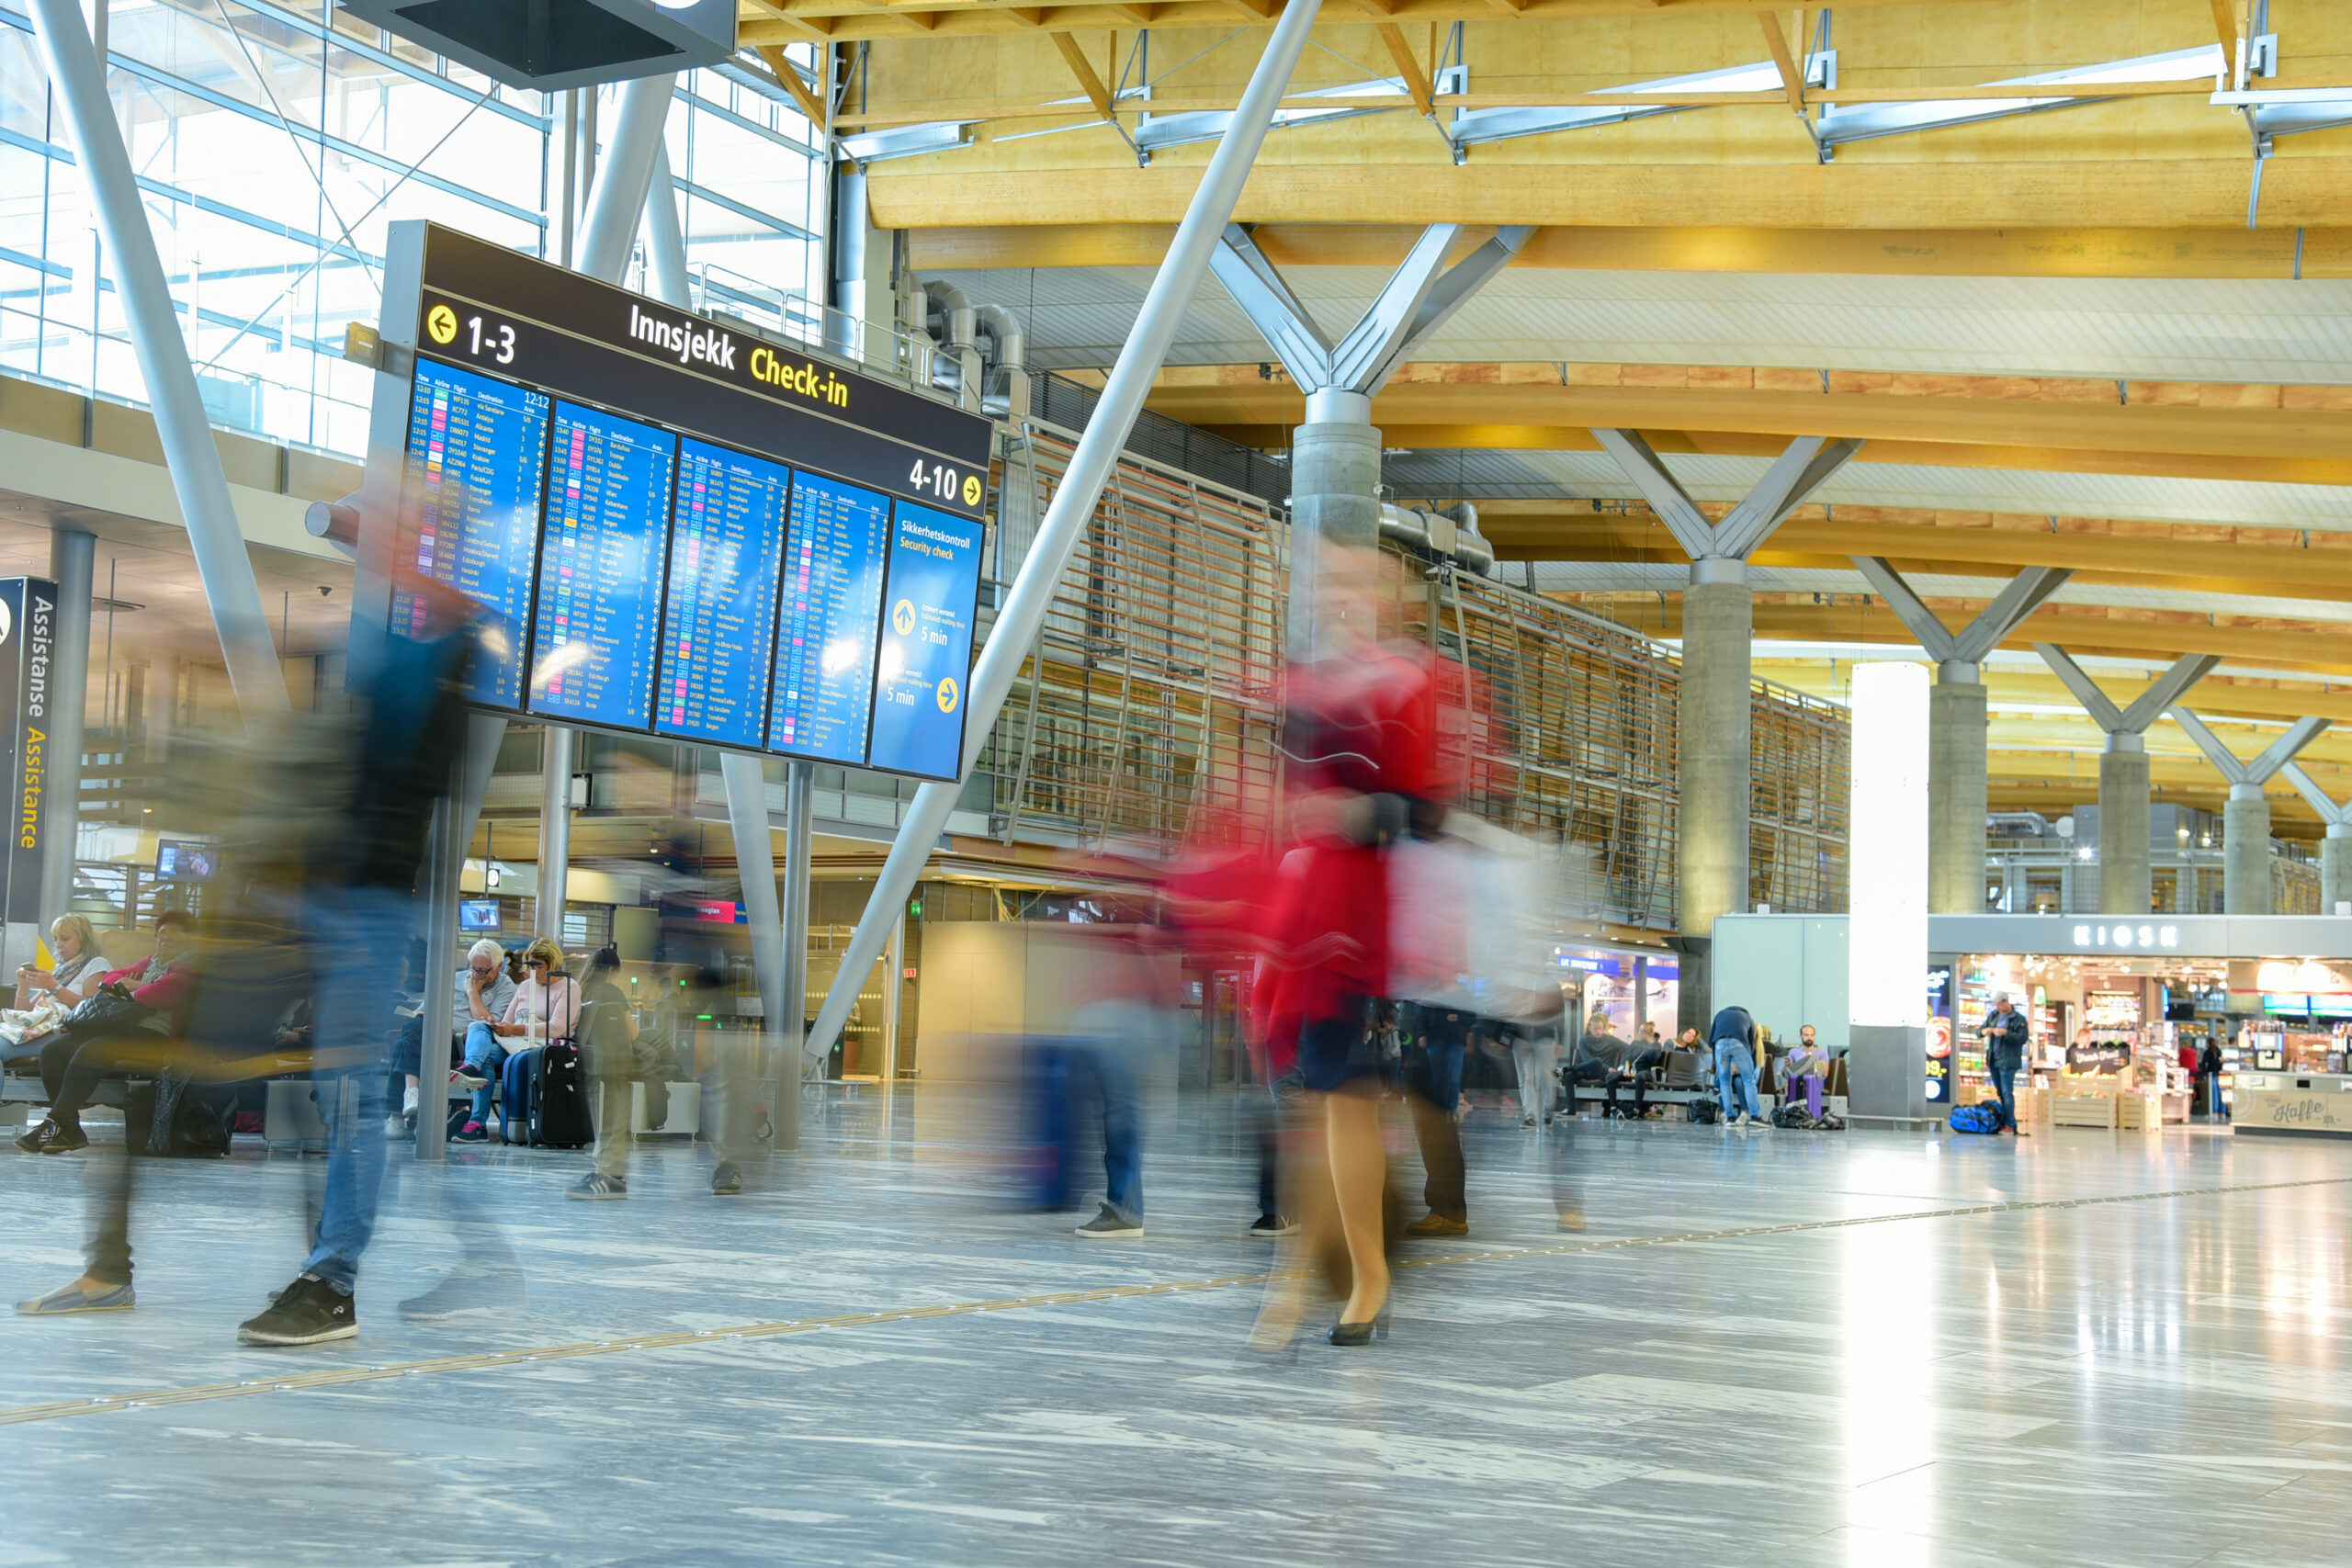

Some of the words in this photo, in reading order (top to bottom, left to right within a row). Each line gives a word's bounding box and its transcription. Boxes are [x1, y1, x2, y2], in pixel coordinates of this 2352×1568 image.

[468, 316, 516, 364] 1-3
[629, 304, 738, 371] Innsjekk
[750, 347, 849, 409] Check-in
[417, 385, 431, 395] 12:10
[418, 374, 429, 383] Time
[435, 379, 450, 389] Airline
[454, 385, 467, 394] Flight
[478, 392, 503, 405] Destination
[524, 406, 535, 414] Area
[525, 392, 549, 409] 12:12
[416, 396, 429, 405] 12:15
[476, 413, 493, 424] Antalya
[415, 406, 428, 415] 12:15
[475, 423, 494, 434] Alicante
[414, 416, 427, 425] 12:15
[474, 434, 491, 444] Madrid
[557, 427, 569, 435] 13:40
[558, 416, 568, 425] Time
[572, 421, 586, 430] Airline
[589, 425, 601, 434] Flight
[611, 432, 634, 444] Destination
[413, 437, 425, 446] 12:30
[413, 427, 426, 436] 12:15
[473, 444, 496, 457] Stavanger
[556, 436, 569, 446] 13:40
[412, 448, 424, 457] 12:40
[608, 461, 622, 470] Dublin
[696, 456, 708, 464] Airline
[711, 460, 721, 468] Flight
[731, 466, 752, 476] Destination
[470, 474, 491, 485] Frankfurt
[608, 471, 629, 482] Stockholm
[909, 458, 957, 502] 4-10
[469, 485, 492, 497] Stavanger
[469, 495, 492, 506] Trondheim
[838, 496, 856, 505] Destination
[604, 519, 617, 528] Bergen
[605, 510, 625, 520] Stockholm
[901, 520, 970, 549] Sikkerhetskontroll
[899, 536, 932, 557] Security
[933, 543, 954, 560] check
[463, 557, 485, 568] Edinburgh
[462, 567, 480, 577] Helsinki
[459, 588, 500, 603] London/Heathrow
[922, 604, 939, 615] Estimert
[939, 608, 956, 618] ventetid
[594, 625, 606, 633] Dubai
[921, 626, 928, 641] 5
[930, 629, 948, 646] min
[28, 595, 54, 718] Assistanse
[887, 686, 894, 702] 5
[896, 689, 914, 705] min
[20, 727, 46, 850] Assistance
[2074, 925, 2177, 947] KIOSK
[2273, 1100, 2324, 1122] Kaffe
